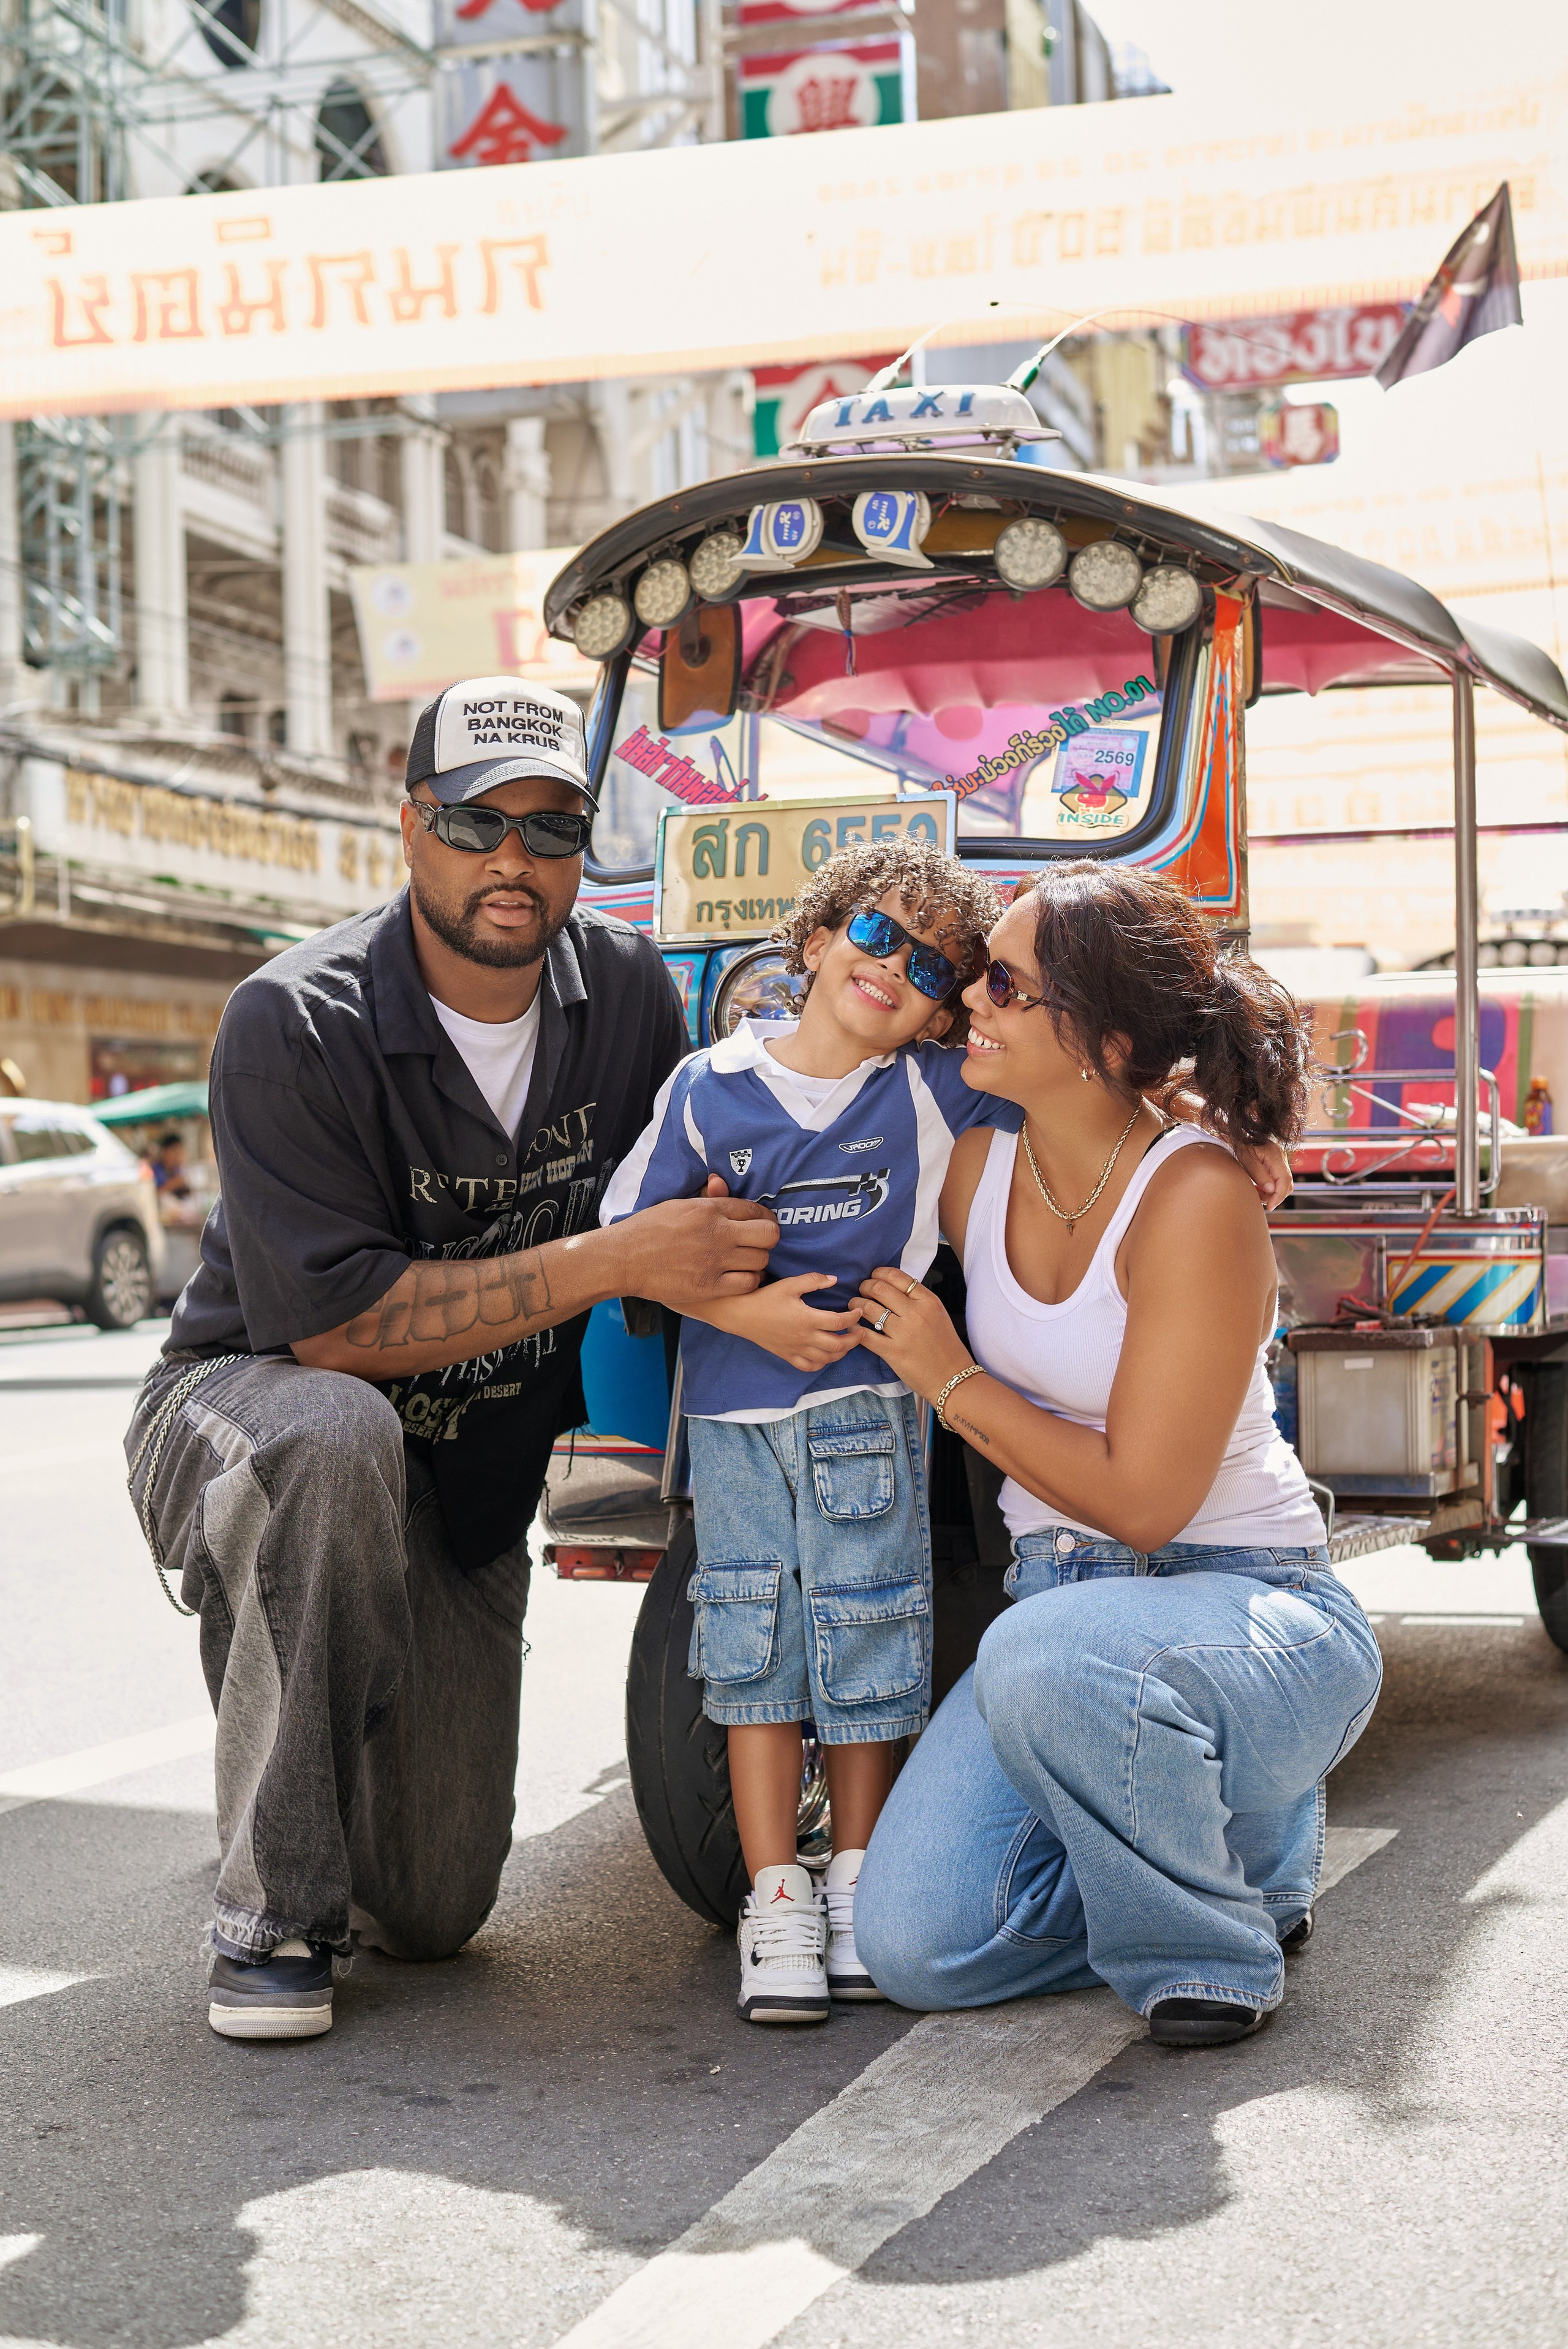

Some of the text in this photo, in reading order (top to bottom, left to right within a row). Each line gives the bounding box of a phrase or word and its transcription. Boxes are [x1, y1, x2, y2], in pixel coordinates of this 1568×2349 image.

[834, 390, 976, 427] TAXI
[463, 701, 564, 724] NOT FROM
[467, 717, 563, 739] BANGKOK
[474, 733, 560, 752] NA KRUB
[1094, 750, 1134, 766] 2569
[1060, 813, 1125, 824] INSIDE
[692, 818, 769, 878] สก
[697, 897, 796, 929] กรุงเทพ
[771, 1199, 862, 1224] ORING
